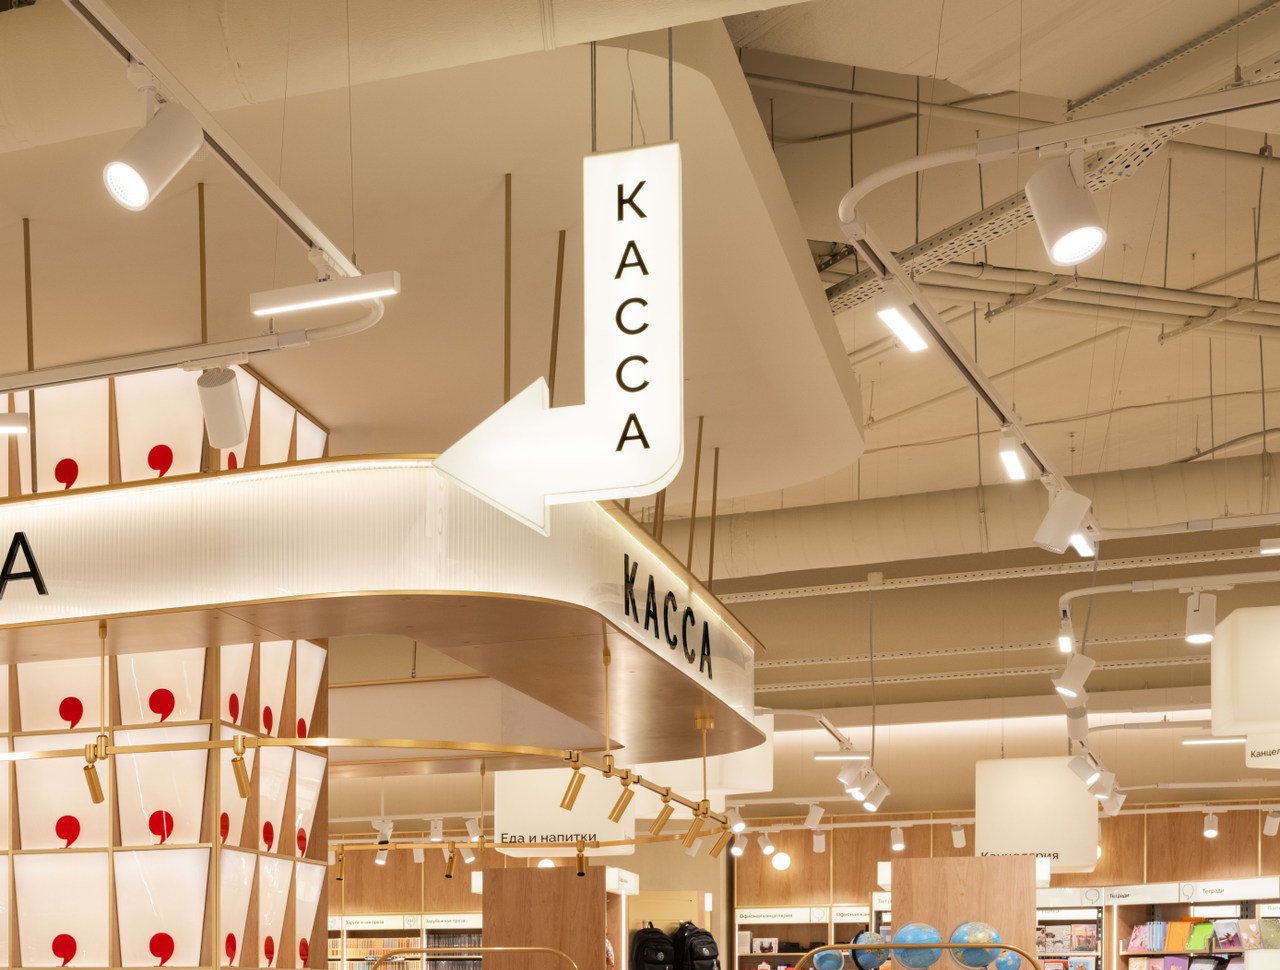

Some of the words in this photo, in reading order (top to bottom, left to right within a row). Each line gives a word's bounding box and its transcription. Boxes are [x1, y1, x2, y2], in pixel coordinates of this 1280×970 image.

[614, 180, 651, 452] КАССА
[623, 553, 713, 680] КАССА
[501, 832, 525, 844] Еда
[529, 835, 537, 843] и
[541, 833, 597, 843] напитки
